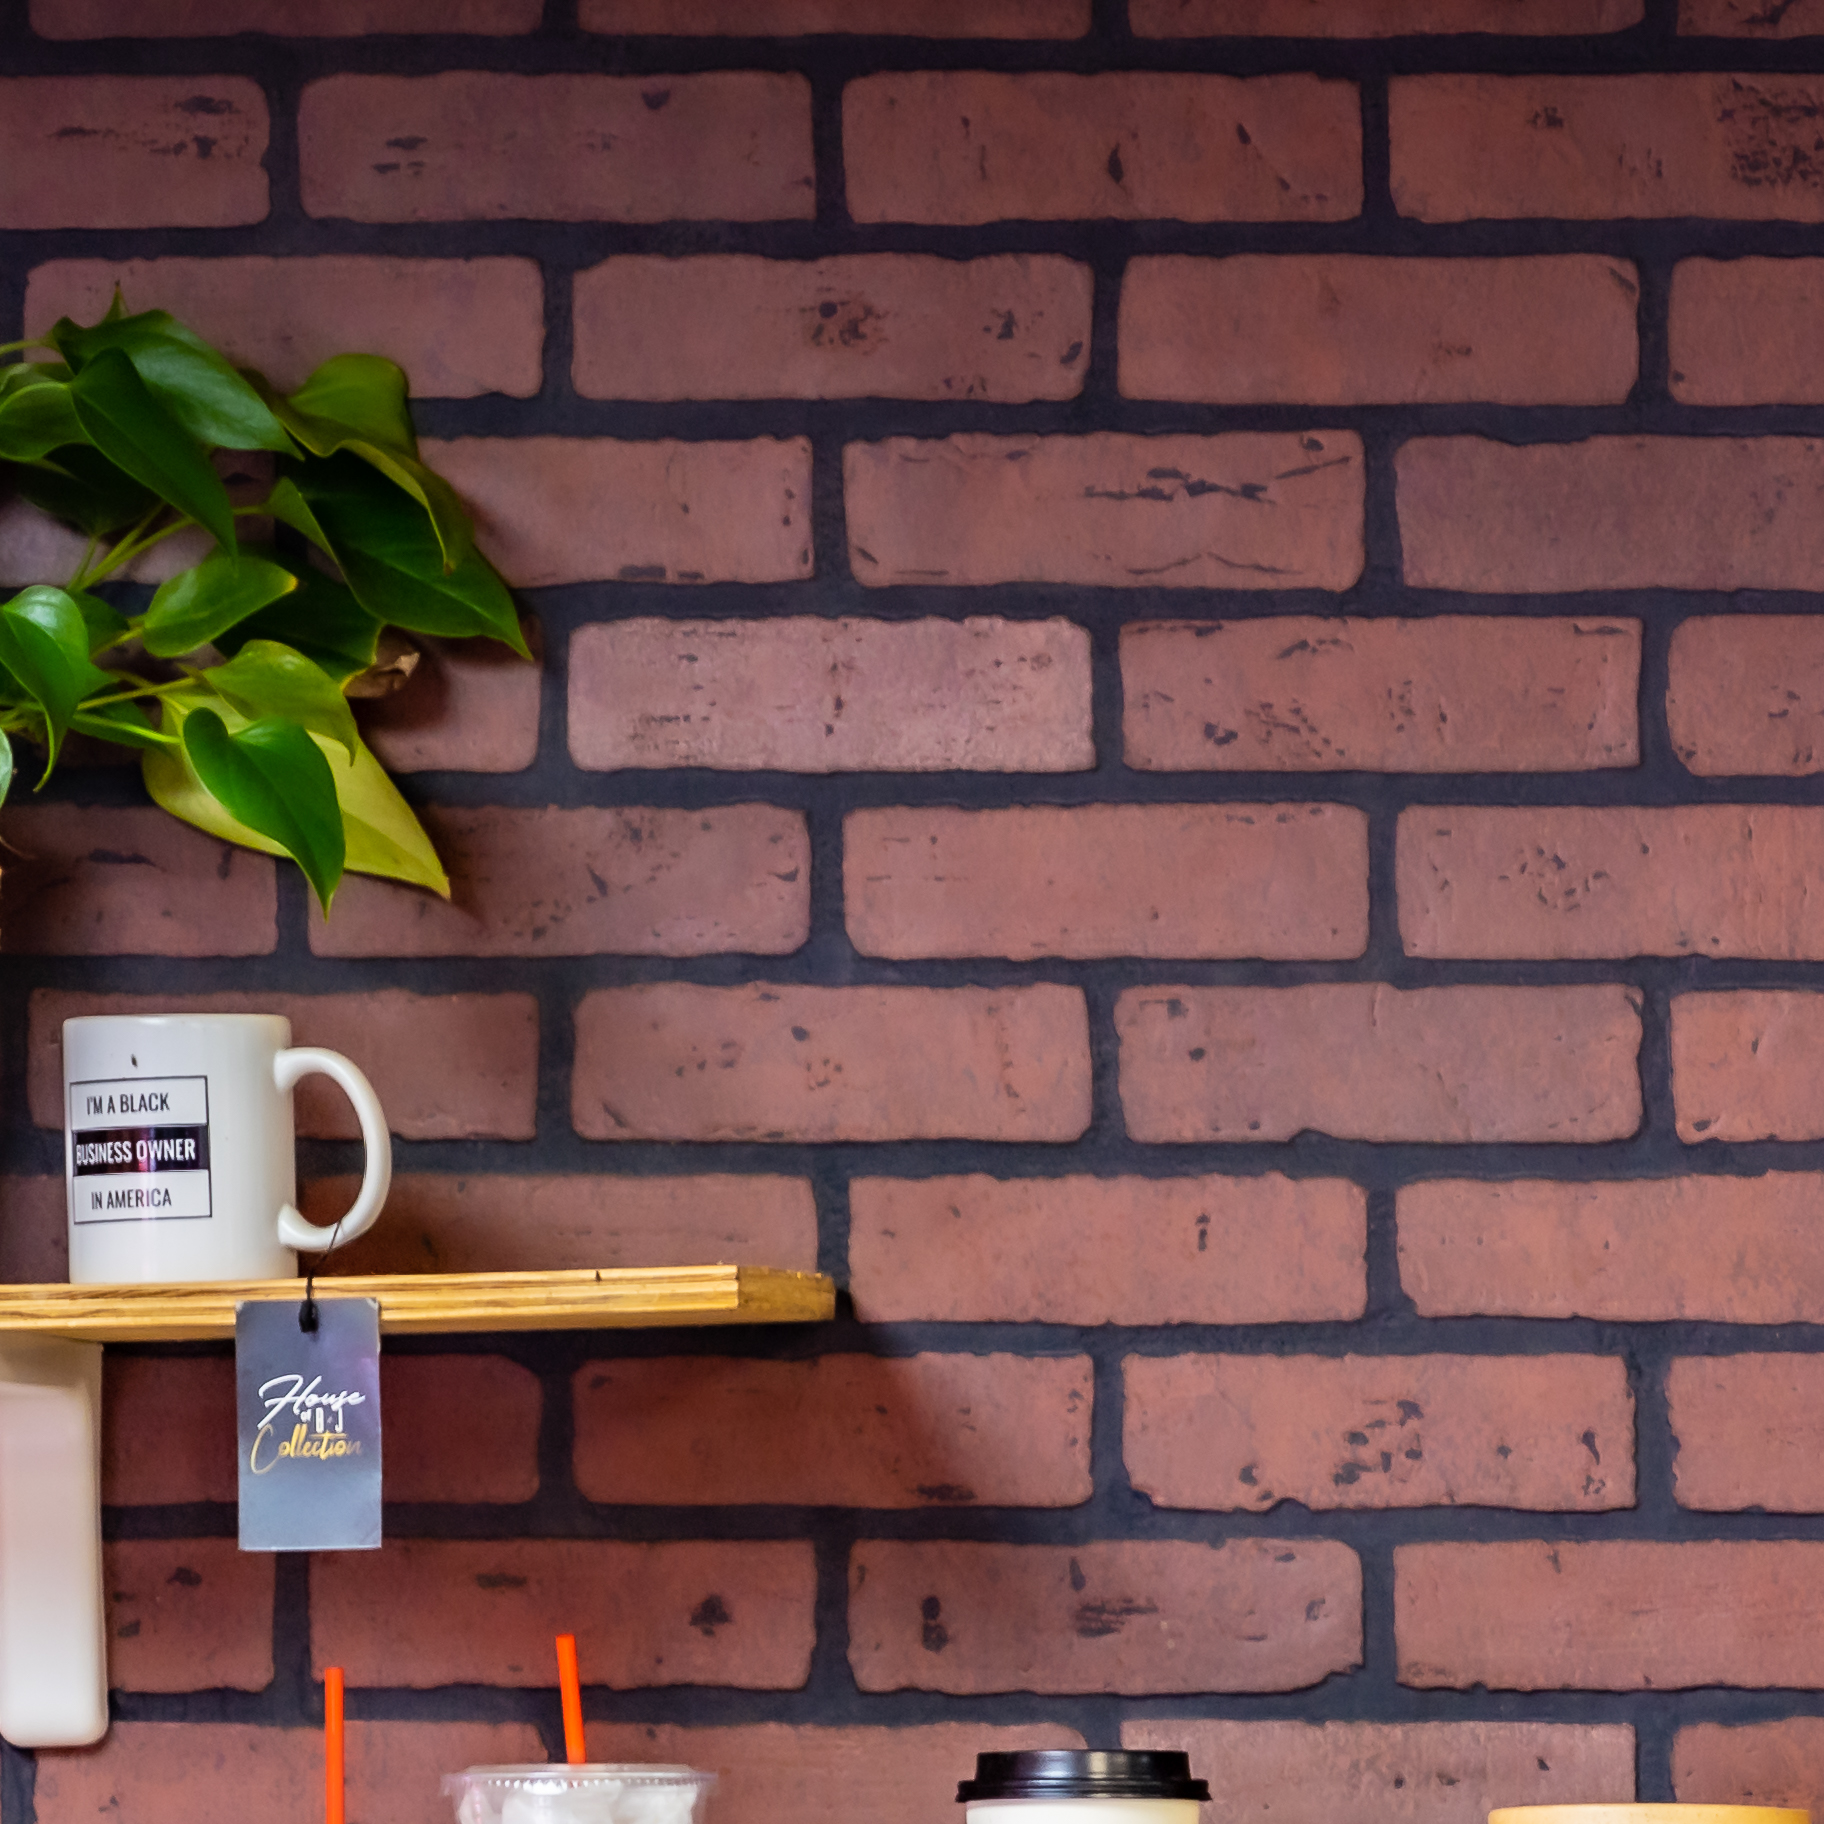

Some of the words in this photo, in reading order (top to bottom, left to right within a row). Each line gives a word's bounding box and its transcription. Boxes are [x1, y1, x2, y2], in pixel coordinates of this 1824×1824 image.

[87, 1095, 103, 1115] I'M
[107, 1095, 116, 1115] A
[120, 1092, 170, 1113] BLACK
[76, 1140, 133, 1165] BUSINESS
[136, 1138, 196, 1162] OWNER
[91, 1190, 103, 1210] IN
[106, 1187, 172, 1209] AMERICA
[257, 1374, 366, 1430] House
[250, 1423, 362, 1475] Collection
